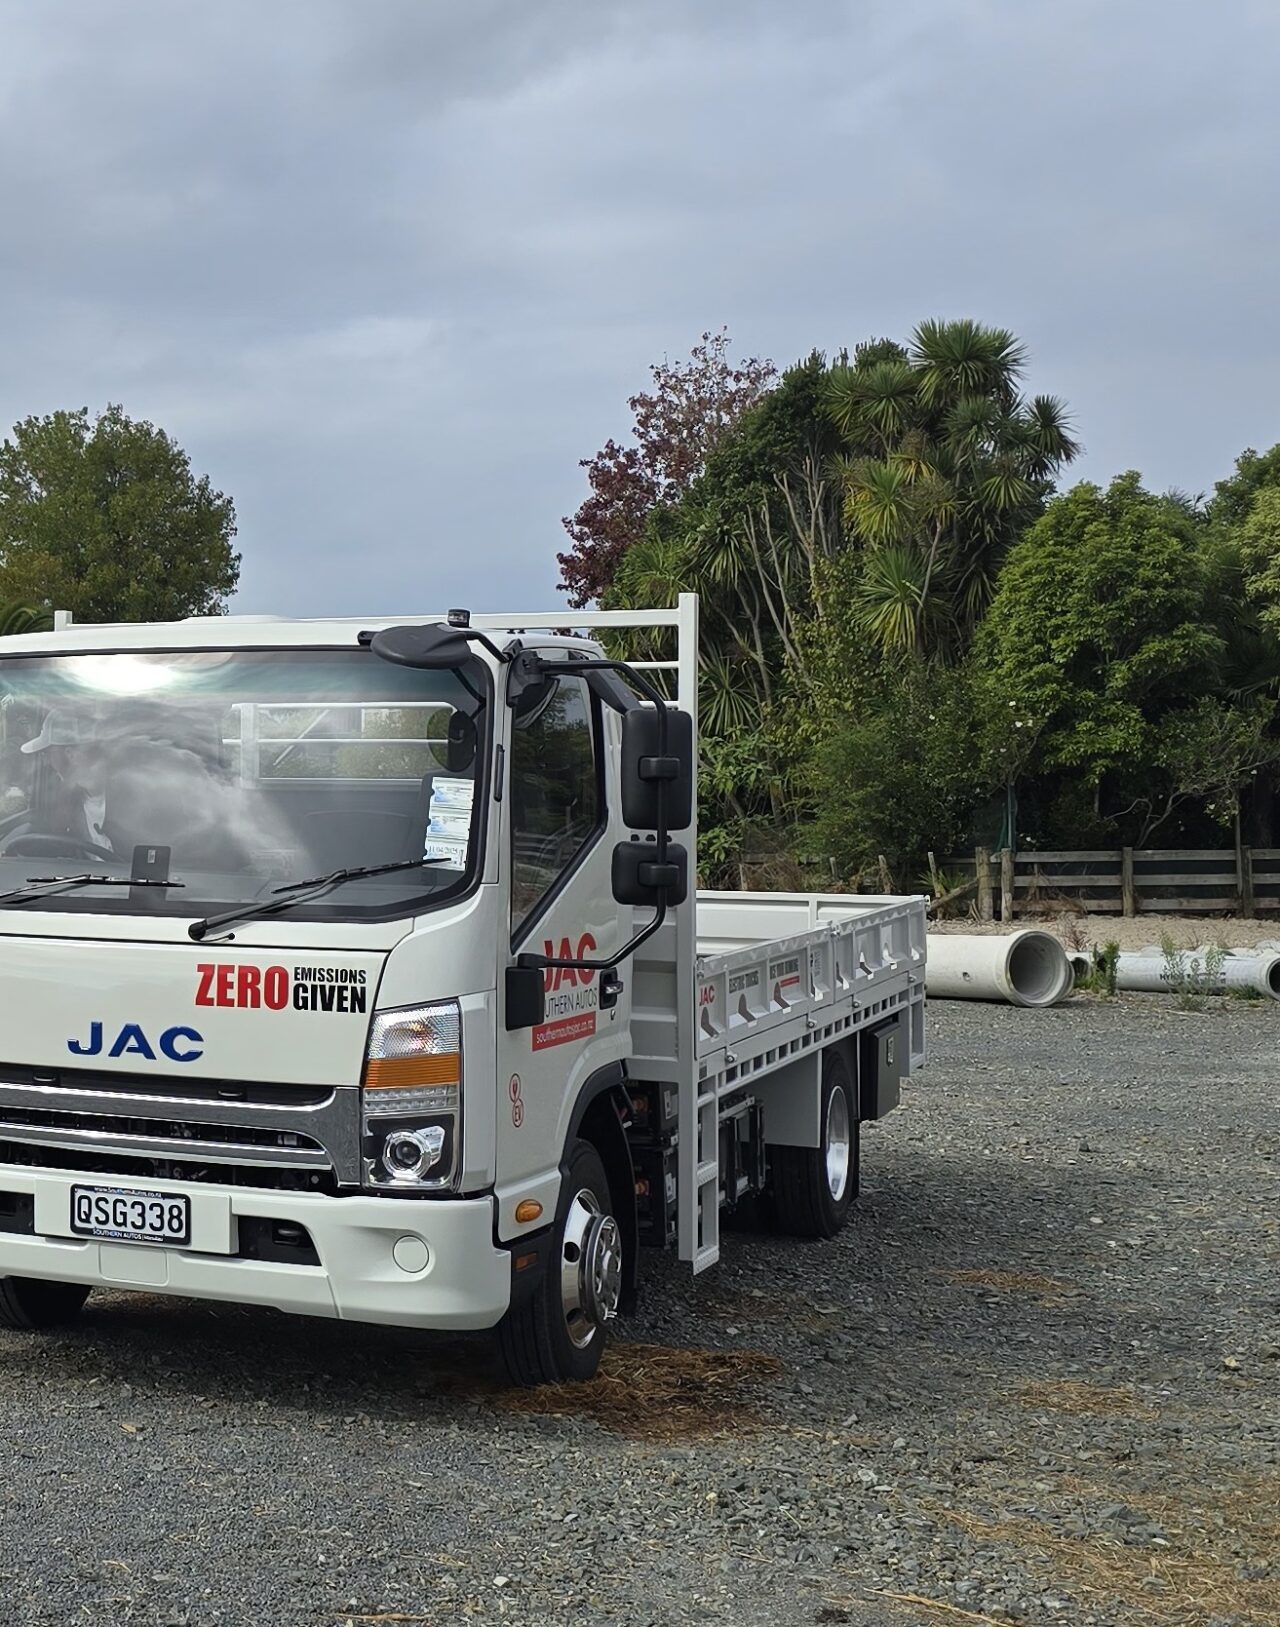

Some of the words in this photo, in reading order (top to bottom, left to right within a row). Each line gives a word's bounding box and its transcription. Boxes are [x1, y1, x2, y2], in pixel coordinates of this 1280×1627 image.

[293, 967, 367, 984] EMISSIONS
[544, 932, 597, 993] JAC
[195, 963, 289, 1010] ZERO
[293, 983, 367, 1013] GIVEN
[699, 985, 716, 1006] JAC
[545, 995, 574, 1018] UTHERN
[575, 988, 598, 1009] AUTOS
[67, 1021, 205, 1062] JAC
[77, 1195, 184, 1233] QSG338
[92, 1228, 122, 1238] SOUTHERN
[123, 1232, 142, 1240] AUTOS
